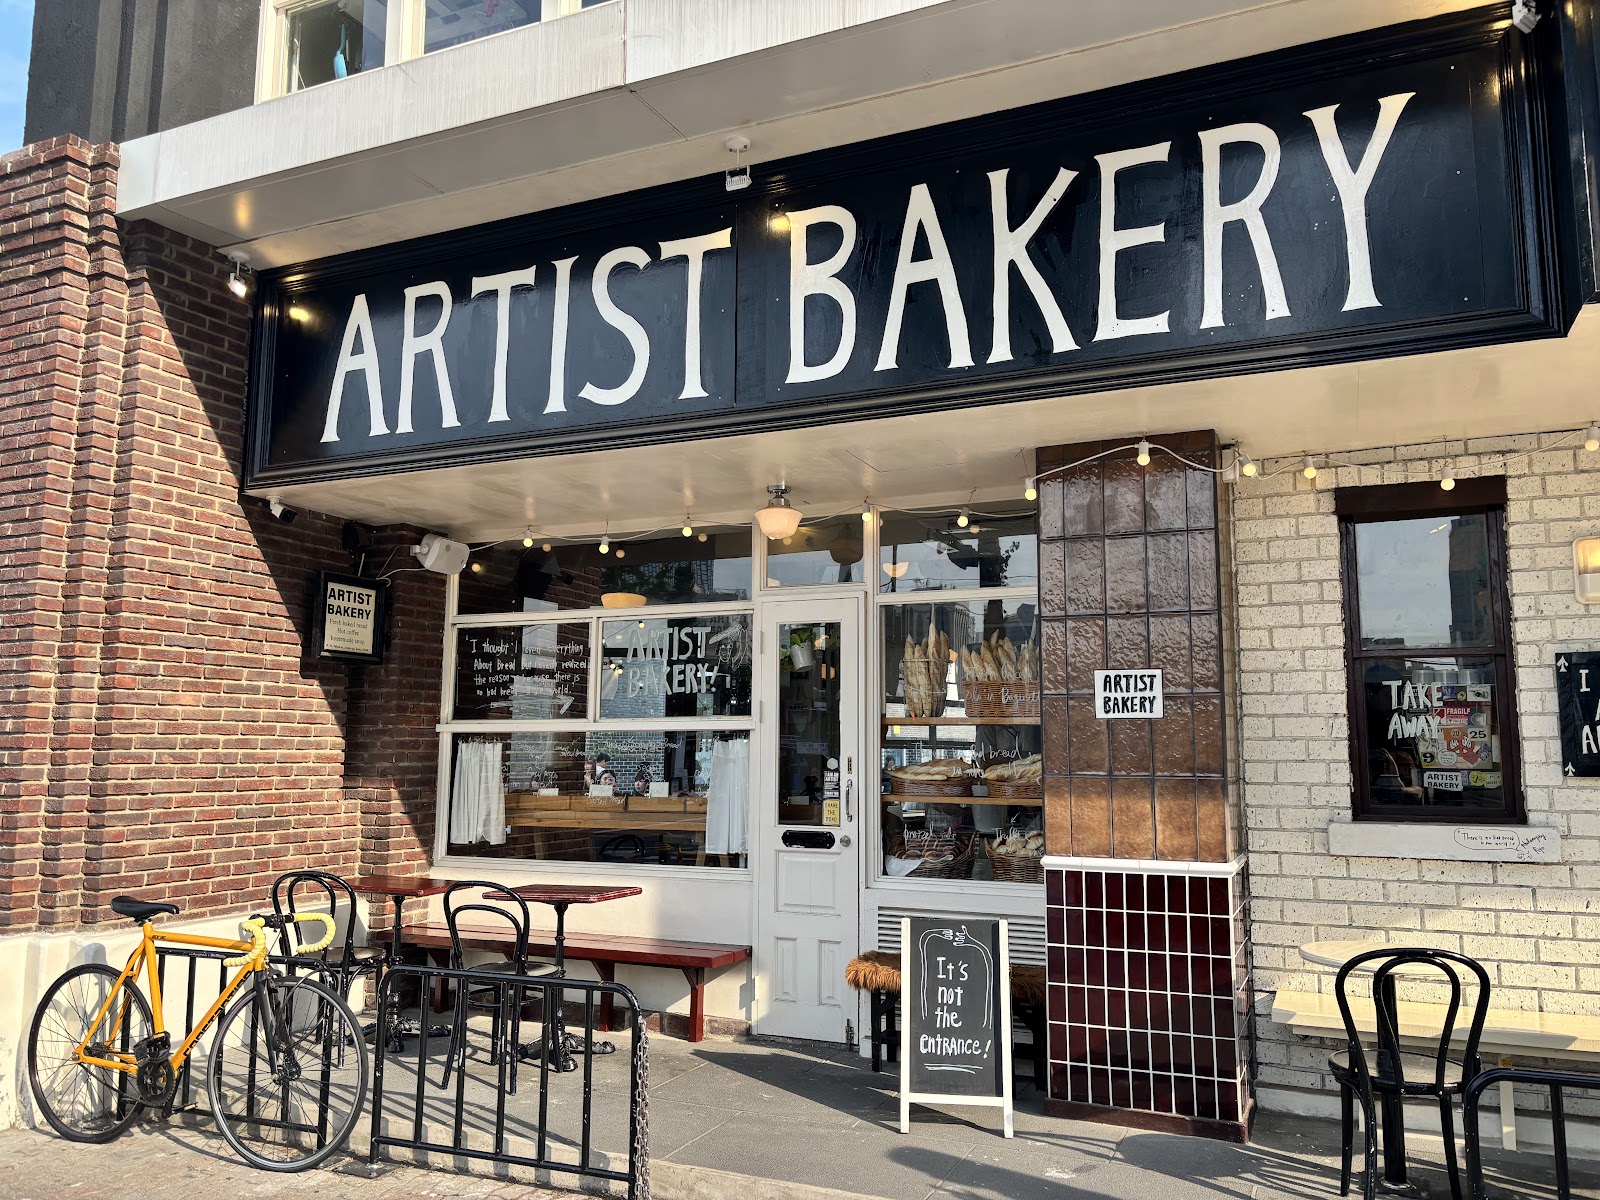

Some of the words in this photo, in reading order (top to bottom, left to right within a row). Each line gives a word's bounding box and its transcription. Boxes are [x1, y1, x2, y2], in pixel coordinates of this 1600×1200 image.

[321, 227, 734, 443] ARTIST
[785, 91, 1416, 385] BAKERY
[328, 588, 372, 605] ARTIST
[327, 604, 371, 620] BAKERY
[626, 626, 711, 663] ARTIST
[474, 658, 492, 672] About
[474, 674, 486, 685] the
[489, 675, 509, 683] reason
[554, 671, 571, 682] there
[628, 663, 719, 698] BAKERY!
[1103, 674, 1157, 693] ARTIST
[1579, 669, 1591, 692] I
[1103, 696, 1156, 714] BAKERY
[1382, 680, 1444, 710] TAKE
[1387, 712, 1441, 740] AWAY
[1469, 731, 1487, 739] 25
[989, 735, 1023, 760] bread
[1427, 773, 1459, 781] ARTIST
[1427, 781, 1460, 789] BAKERY
[937, 957, 969, 981] It's
[938, 986, 964, 1006] not
[935, 1006, 962, 1028] the
